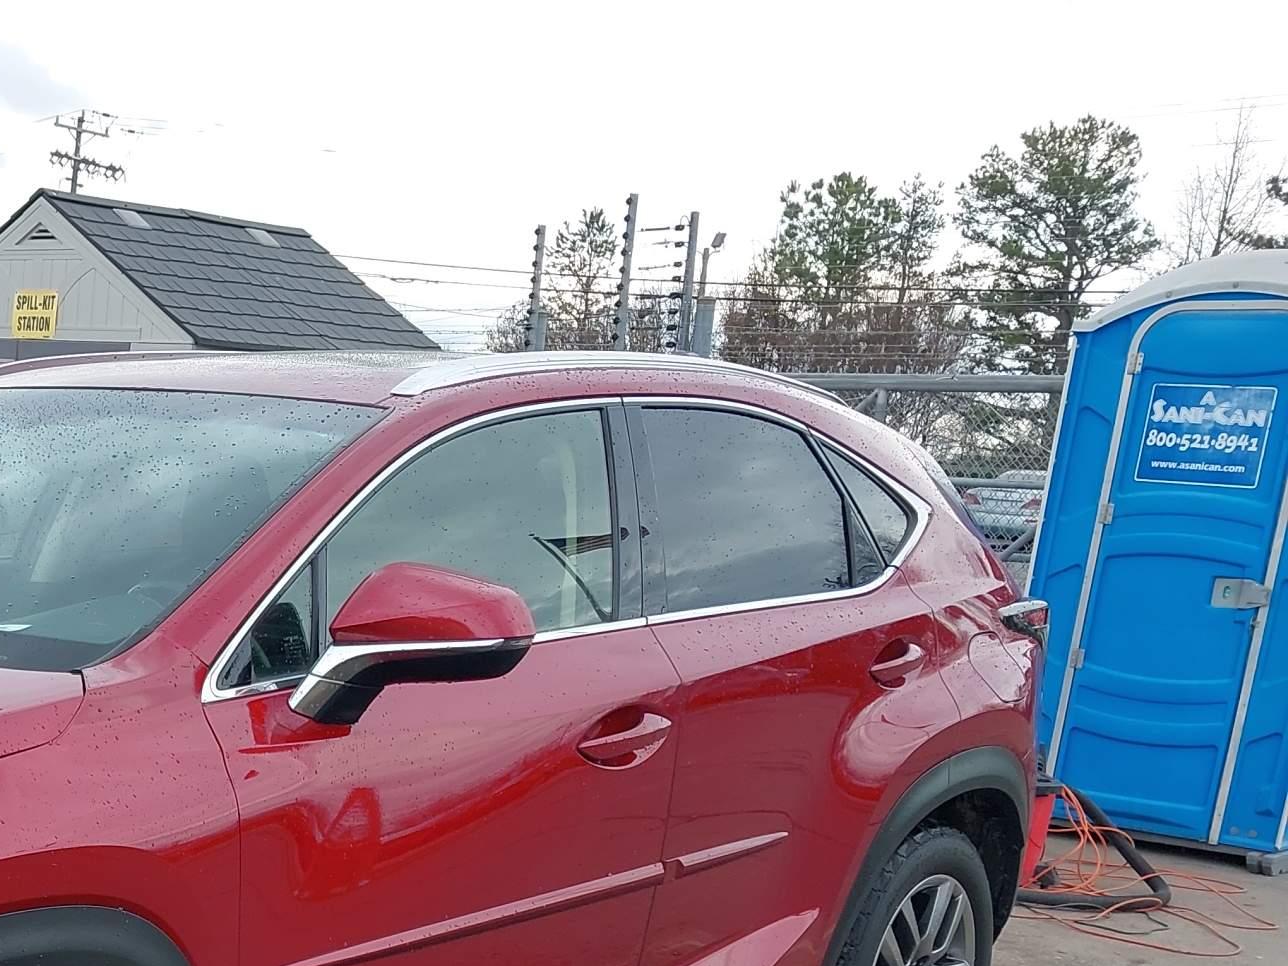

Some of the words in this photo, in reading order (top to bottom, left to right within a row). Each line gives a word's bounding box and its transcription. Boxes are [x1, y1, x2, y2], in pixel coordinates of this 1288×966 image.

[16, 295, 56, 311] SPILL-KIT
[17, 316, 51, 332] STATION
[1199, 391, 1217, 406] A
[1151, 460, 1245, 473] www.asanican.com
